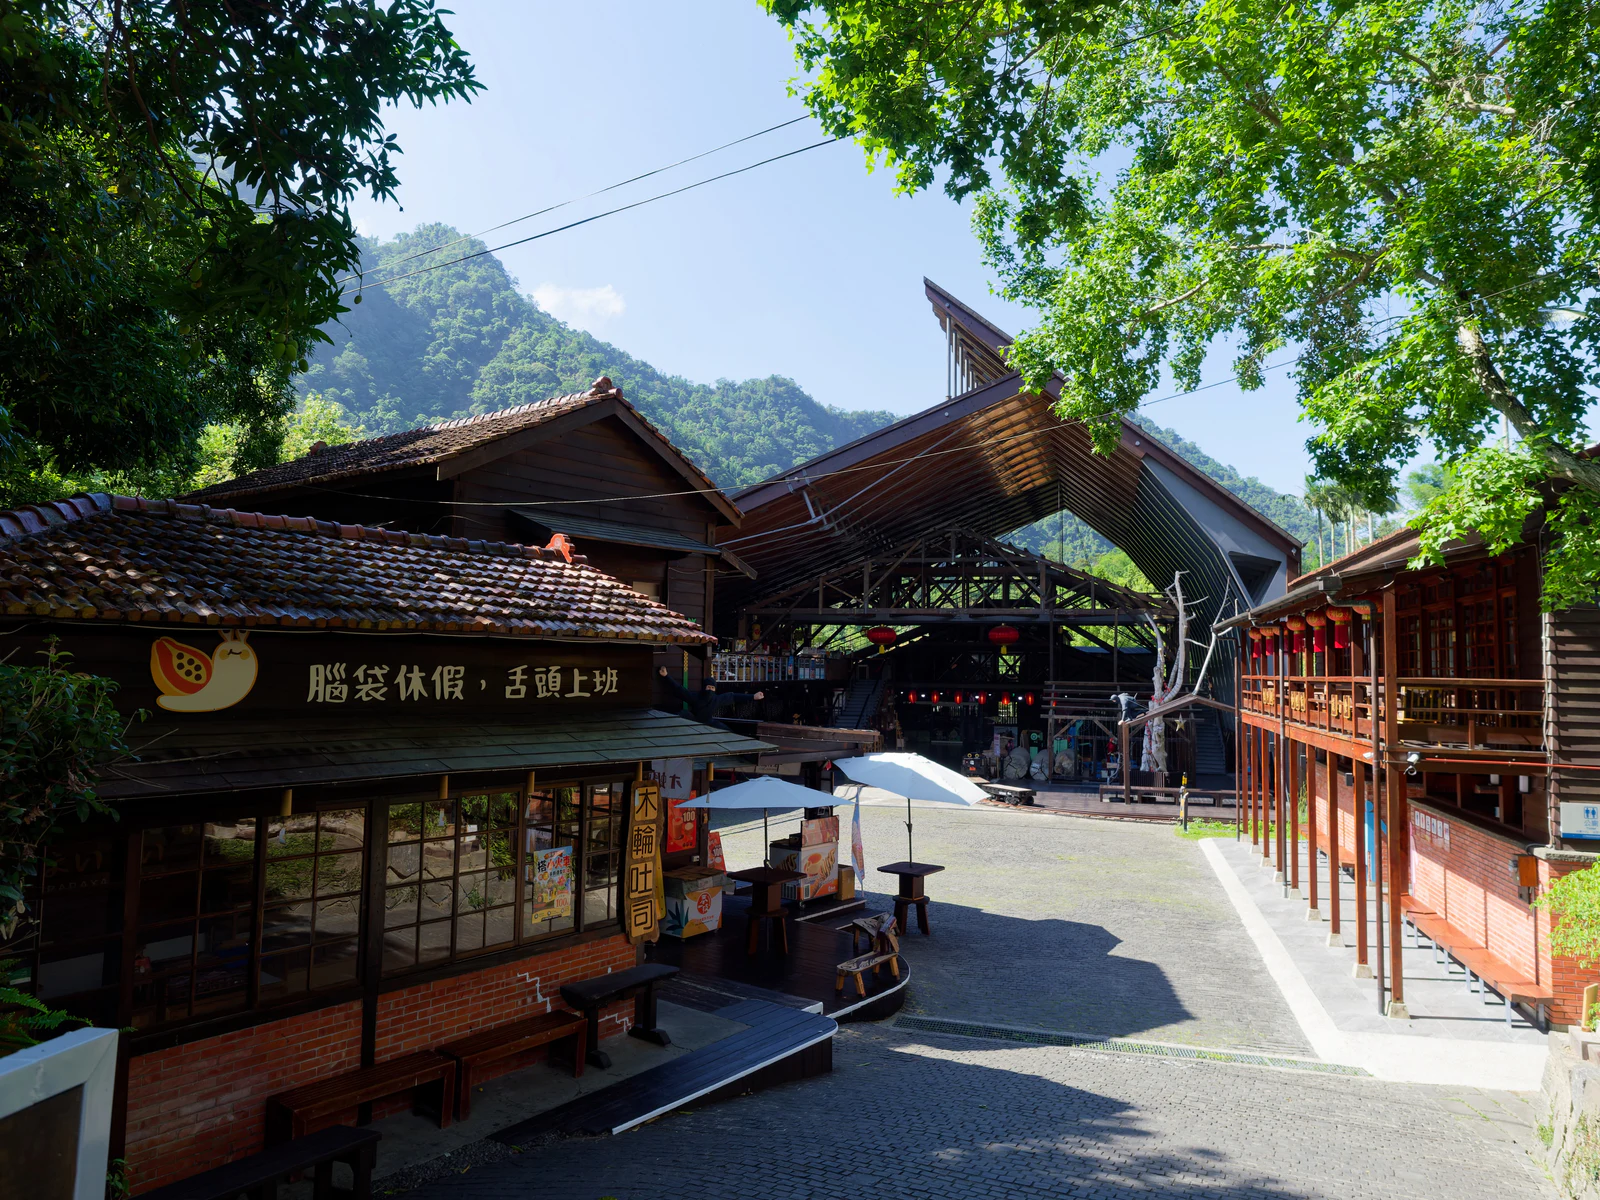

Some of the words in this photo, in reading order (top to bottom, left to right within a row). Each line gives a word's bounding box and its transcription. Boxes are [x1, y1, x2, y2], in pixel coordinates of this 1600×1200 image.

[307, 662, 618, 703] 腦袋休假，舌頭上班
[682, 811, 696, 822] 100
[537, 855, 571, 873] 搭小火車
[631, 788, 657, 930] 木輪吐司
